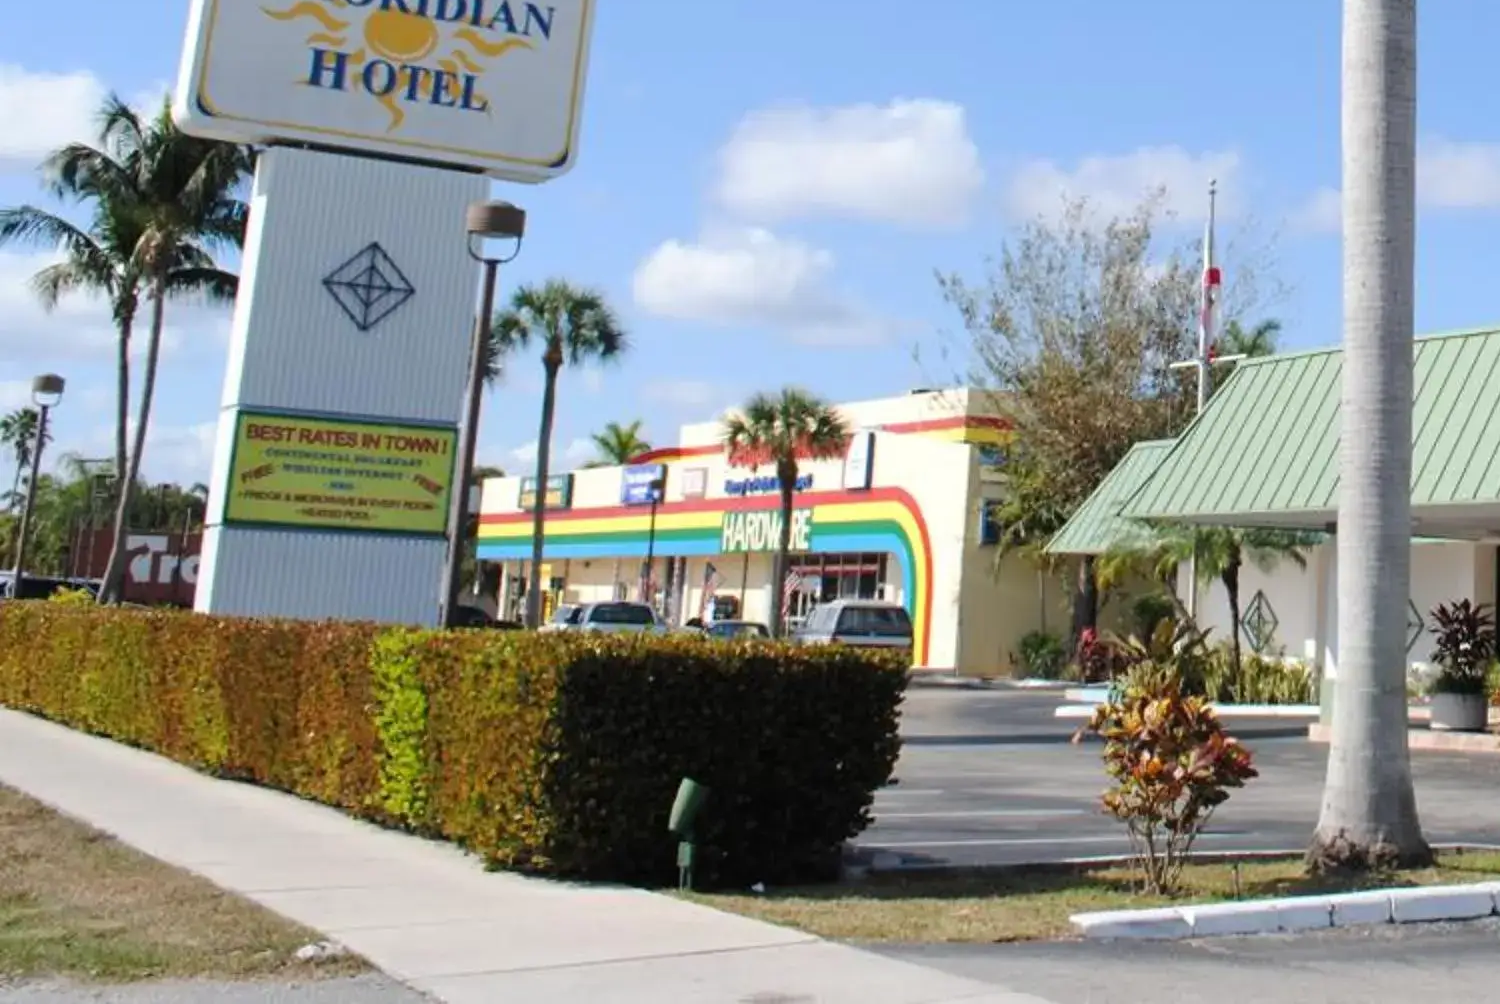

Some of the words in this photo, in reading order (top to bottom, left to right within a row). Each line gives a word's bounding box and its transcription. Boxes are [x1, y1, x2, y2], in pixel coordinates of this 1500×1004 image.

[307, 48, 488, 114] HOTEL
[246, 423, 297, 443] BEST
[299, 428, 358, 448] RATES
[361, 433, 381, 450] IN
[722, 507, 812, 552] HARDWRE
